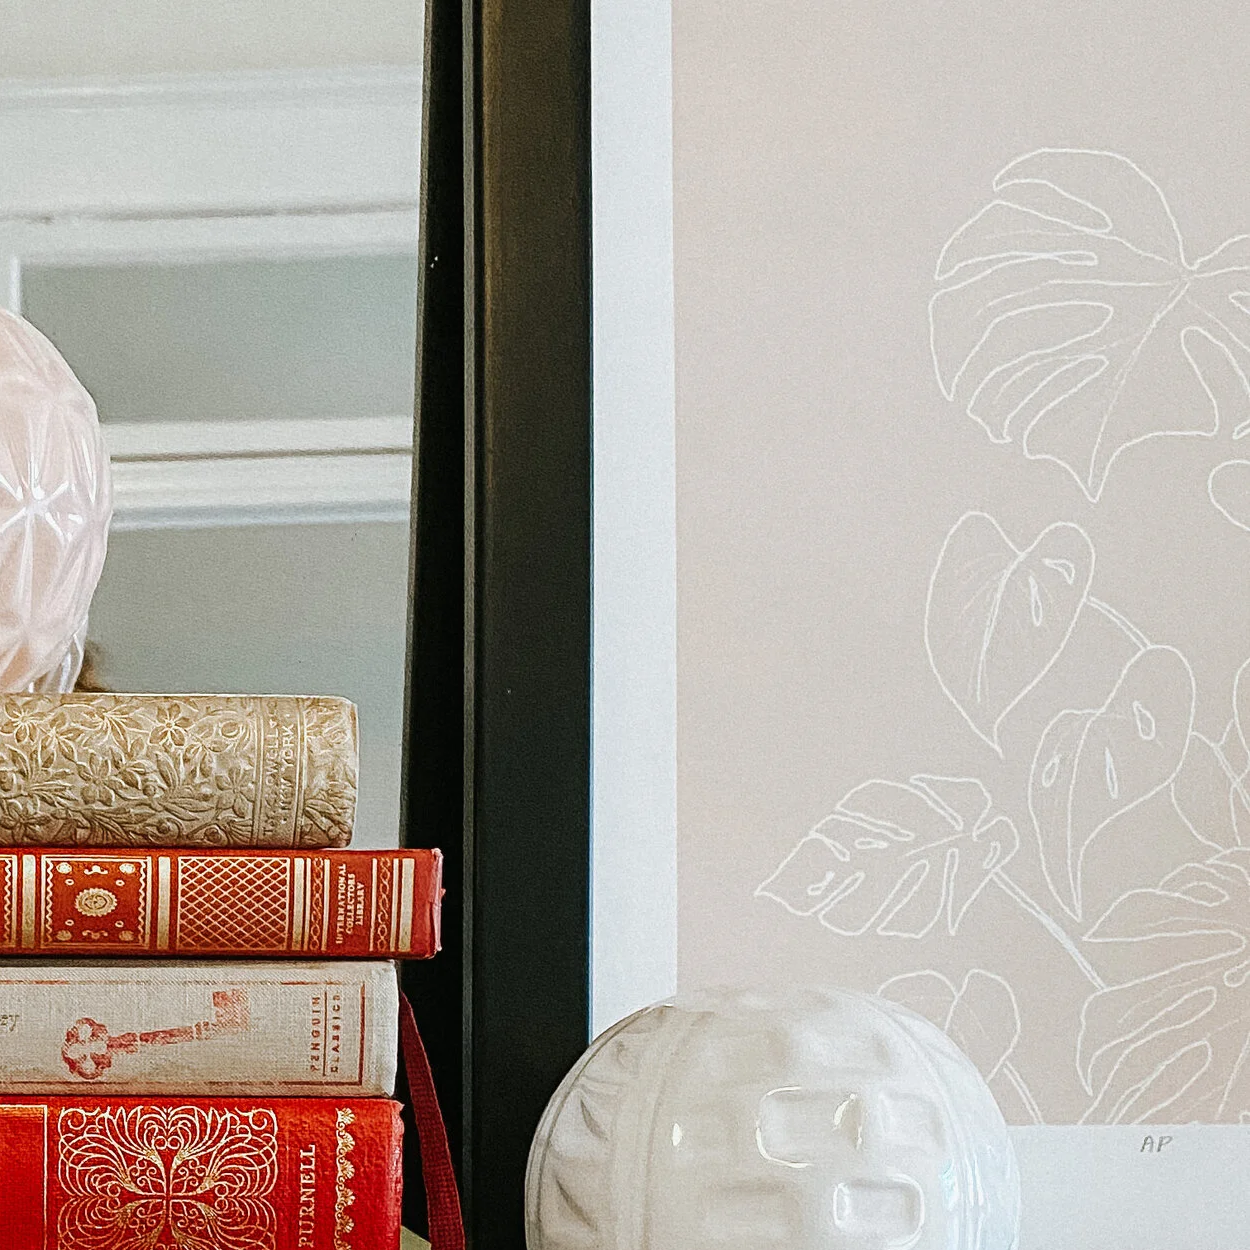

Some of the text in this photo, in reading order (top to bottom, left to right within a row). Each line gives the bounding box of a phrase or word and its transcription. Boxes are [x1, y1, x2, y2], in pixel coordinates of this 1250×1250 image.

[281, 724, 294, 770] YORK
[335, 864, 347, 944] INTERNATIONAL
[346, 873, 356, 935] COLLECTORS
[355, 882, 365, 926] LIBRARY
[310, 997, 321, 1072] PENGUIN
[298, 1144, 316, 1248] PURNELL
